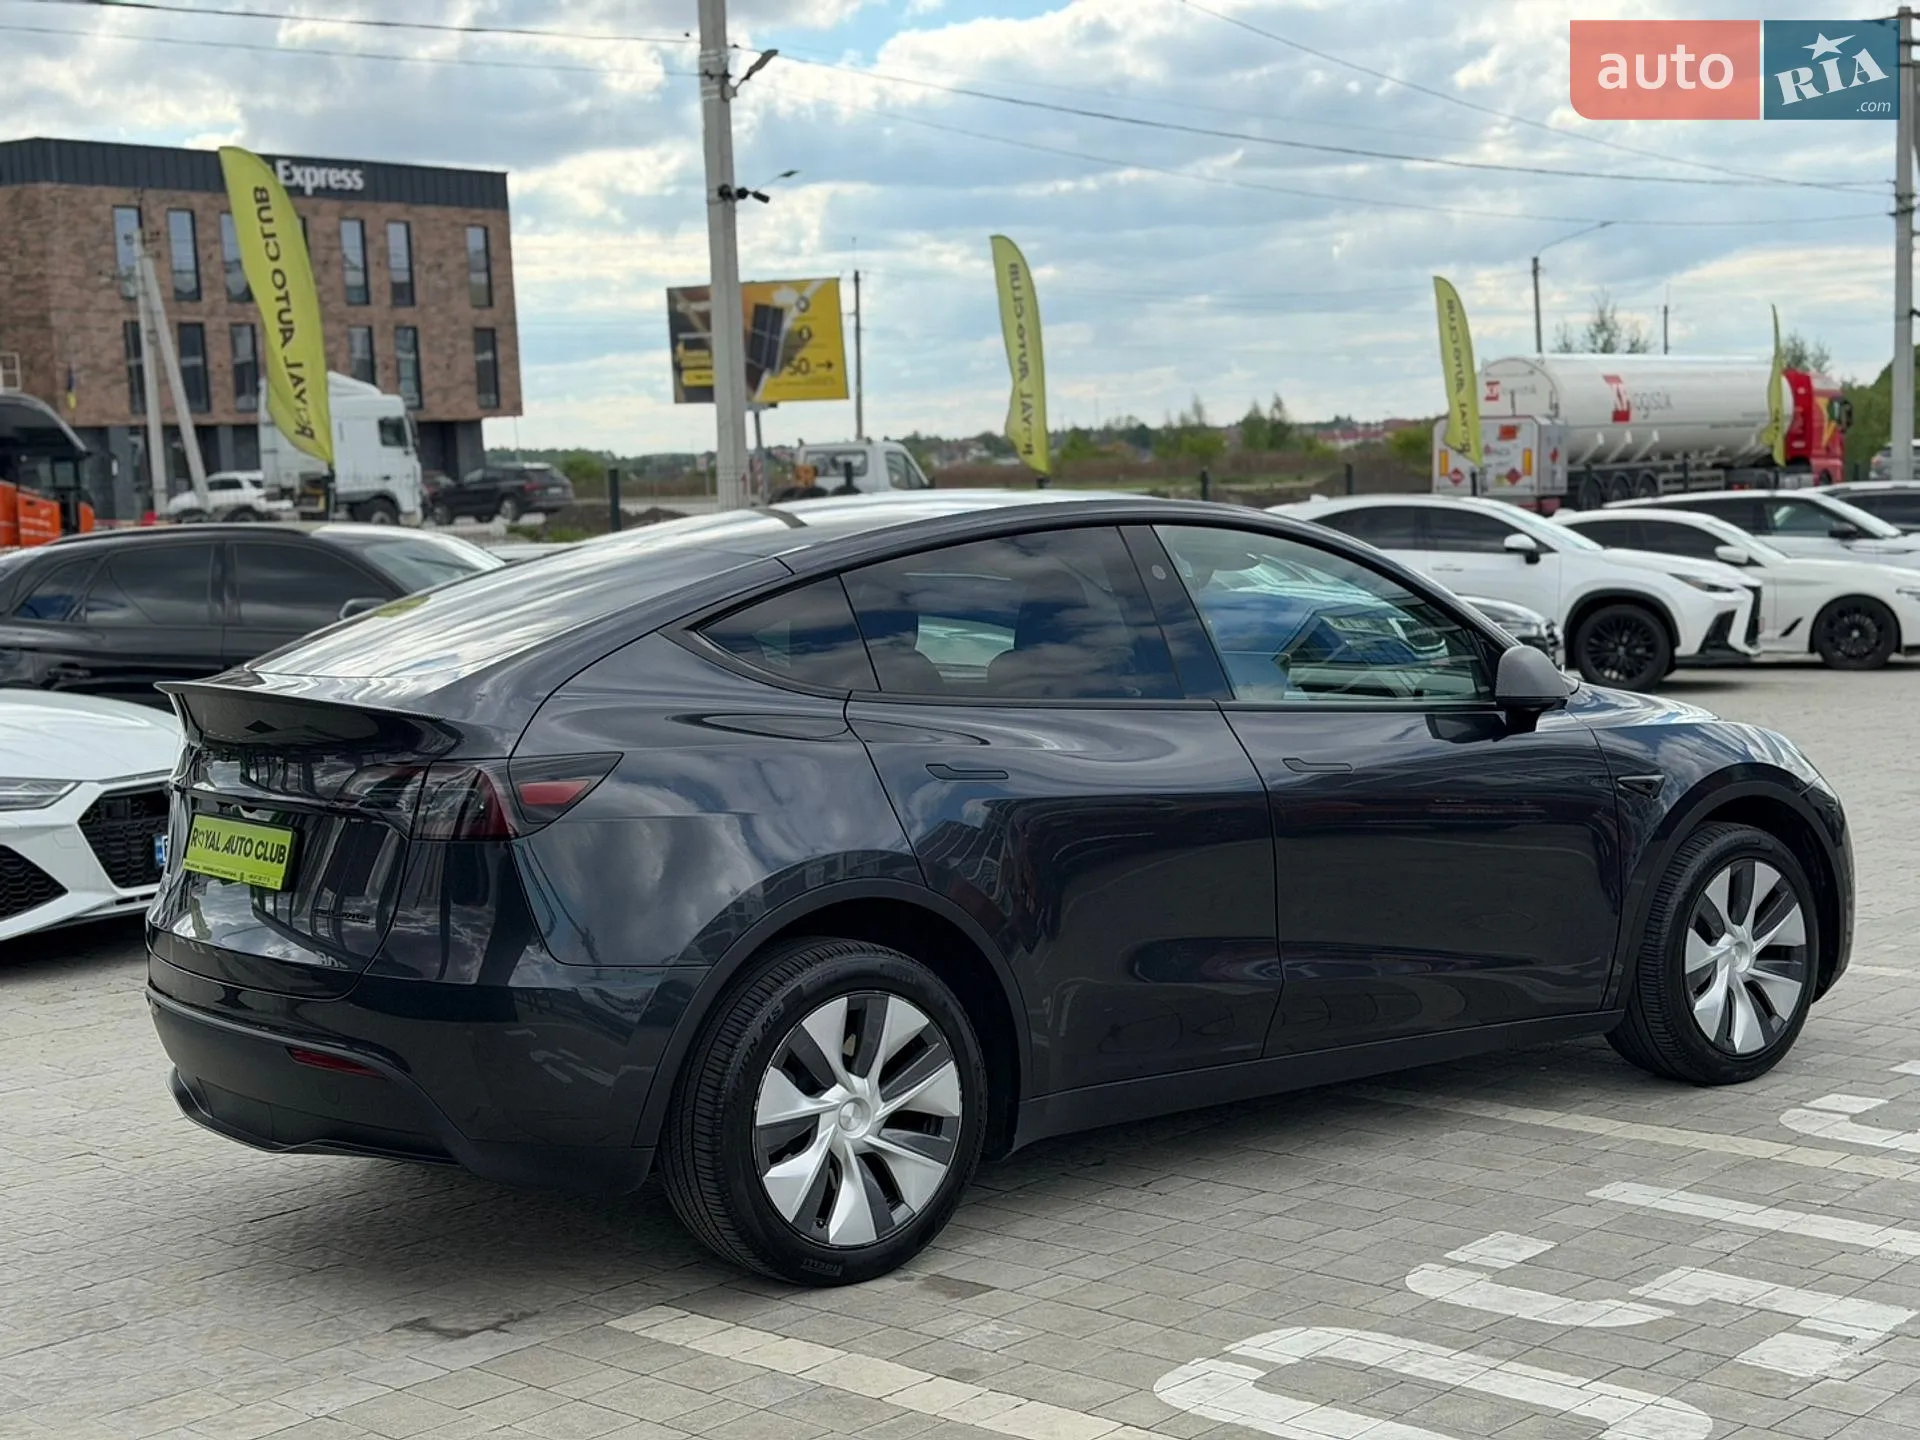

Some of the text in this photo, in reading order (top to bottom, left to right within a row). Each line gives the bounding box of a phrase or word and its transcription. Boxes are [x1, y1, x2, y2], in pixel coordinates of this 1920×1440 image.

[275, 159, 364, 196] Express
[190, 827, 287, 865] ROYAL AUTO CLUB
